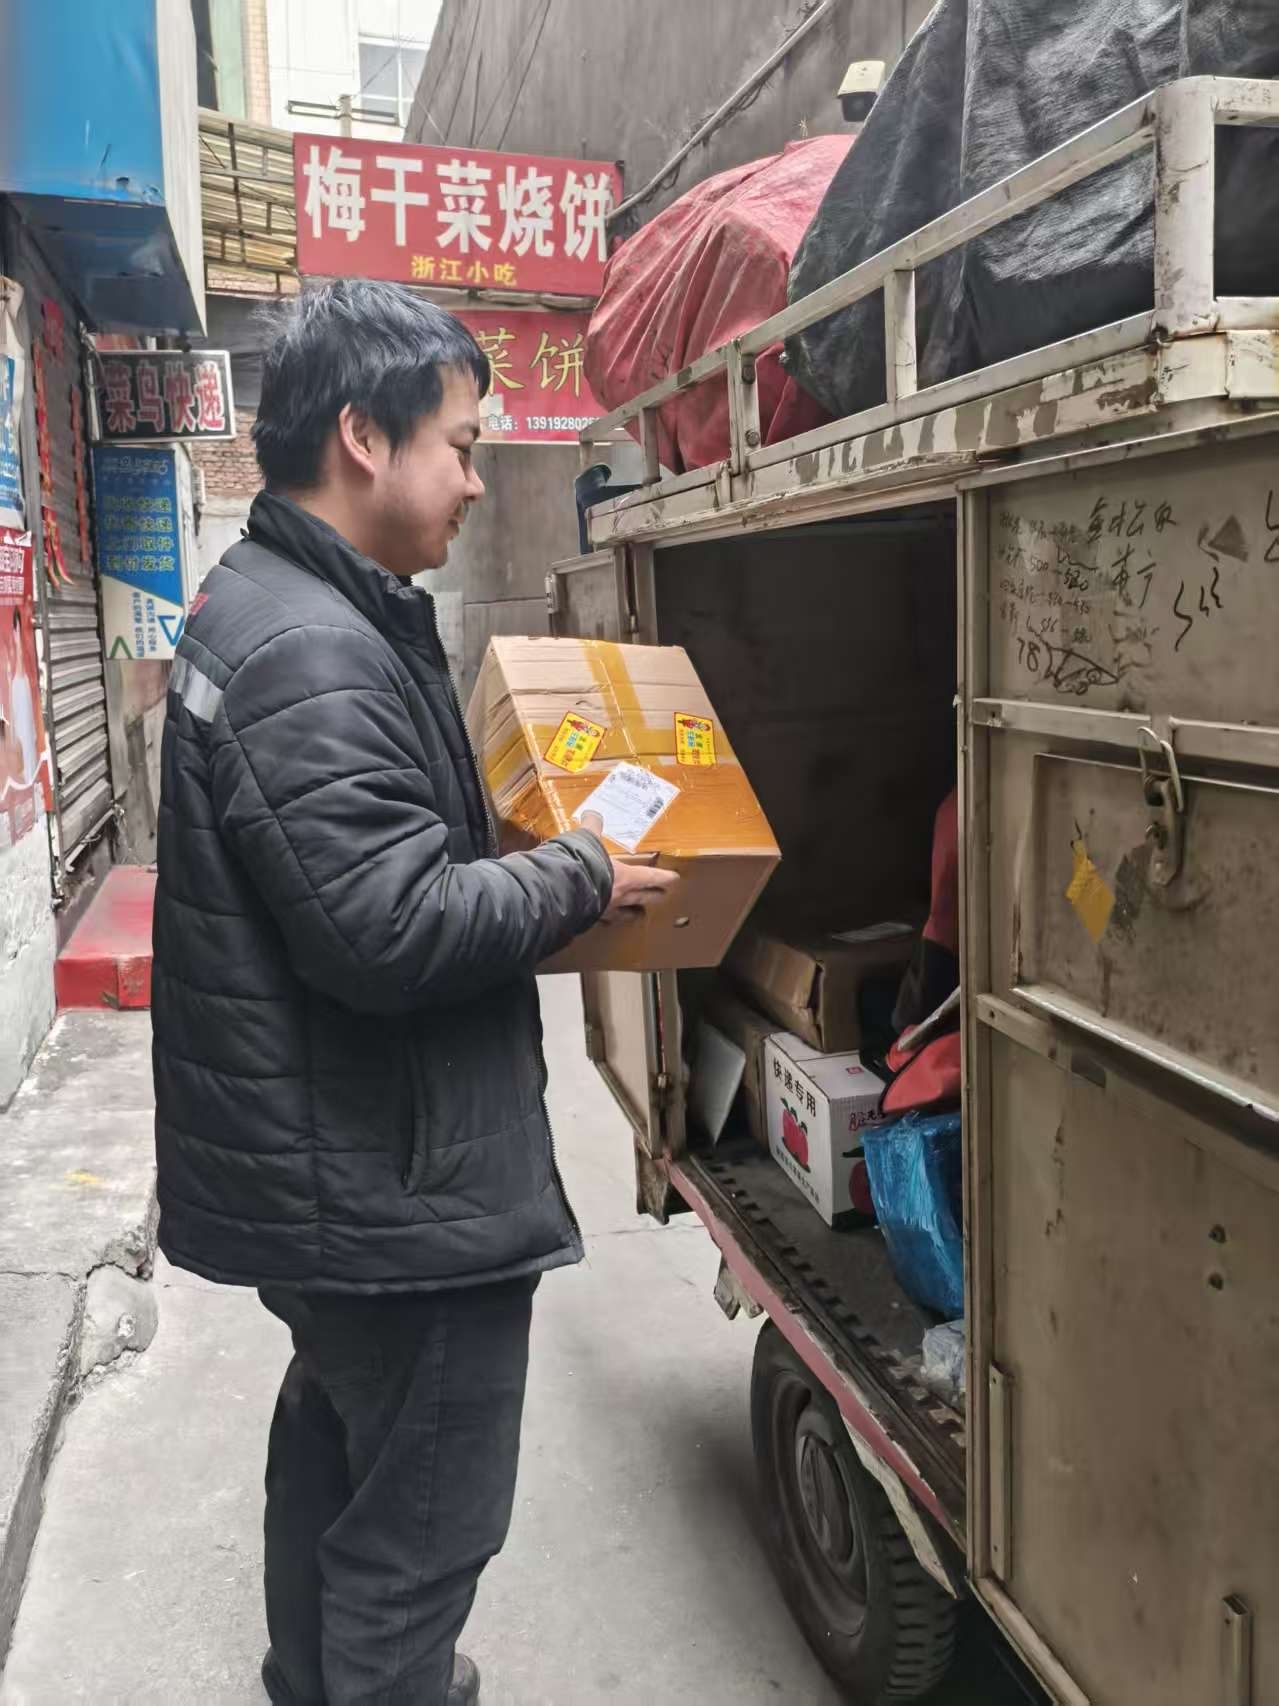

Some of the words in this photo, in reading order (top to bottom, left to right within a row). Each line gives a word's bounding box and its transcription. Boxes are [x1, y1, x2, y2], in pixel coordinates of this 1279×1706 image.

[303, 145, 611, 263] 梅干菜烧饼
[411, 255, 517, 286] 浙江小吃
[105, 360, 225, 433] 菜鸟快递
[773, 1057, 817, 1117] 快递专用
